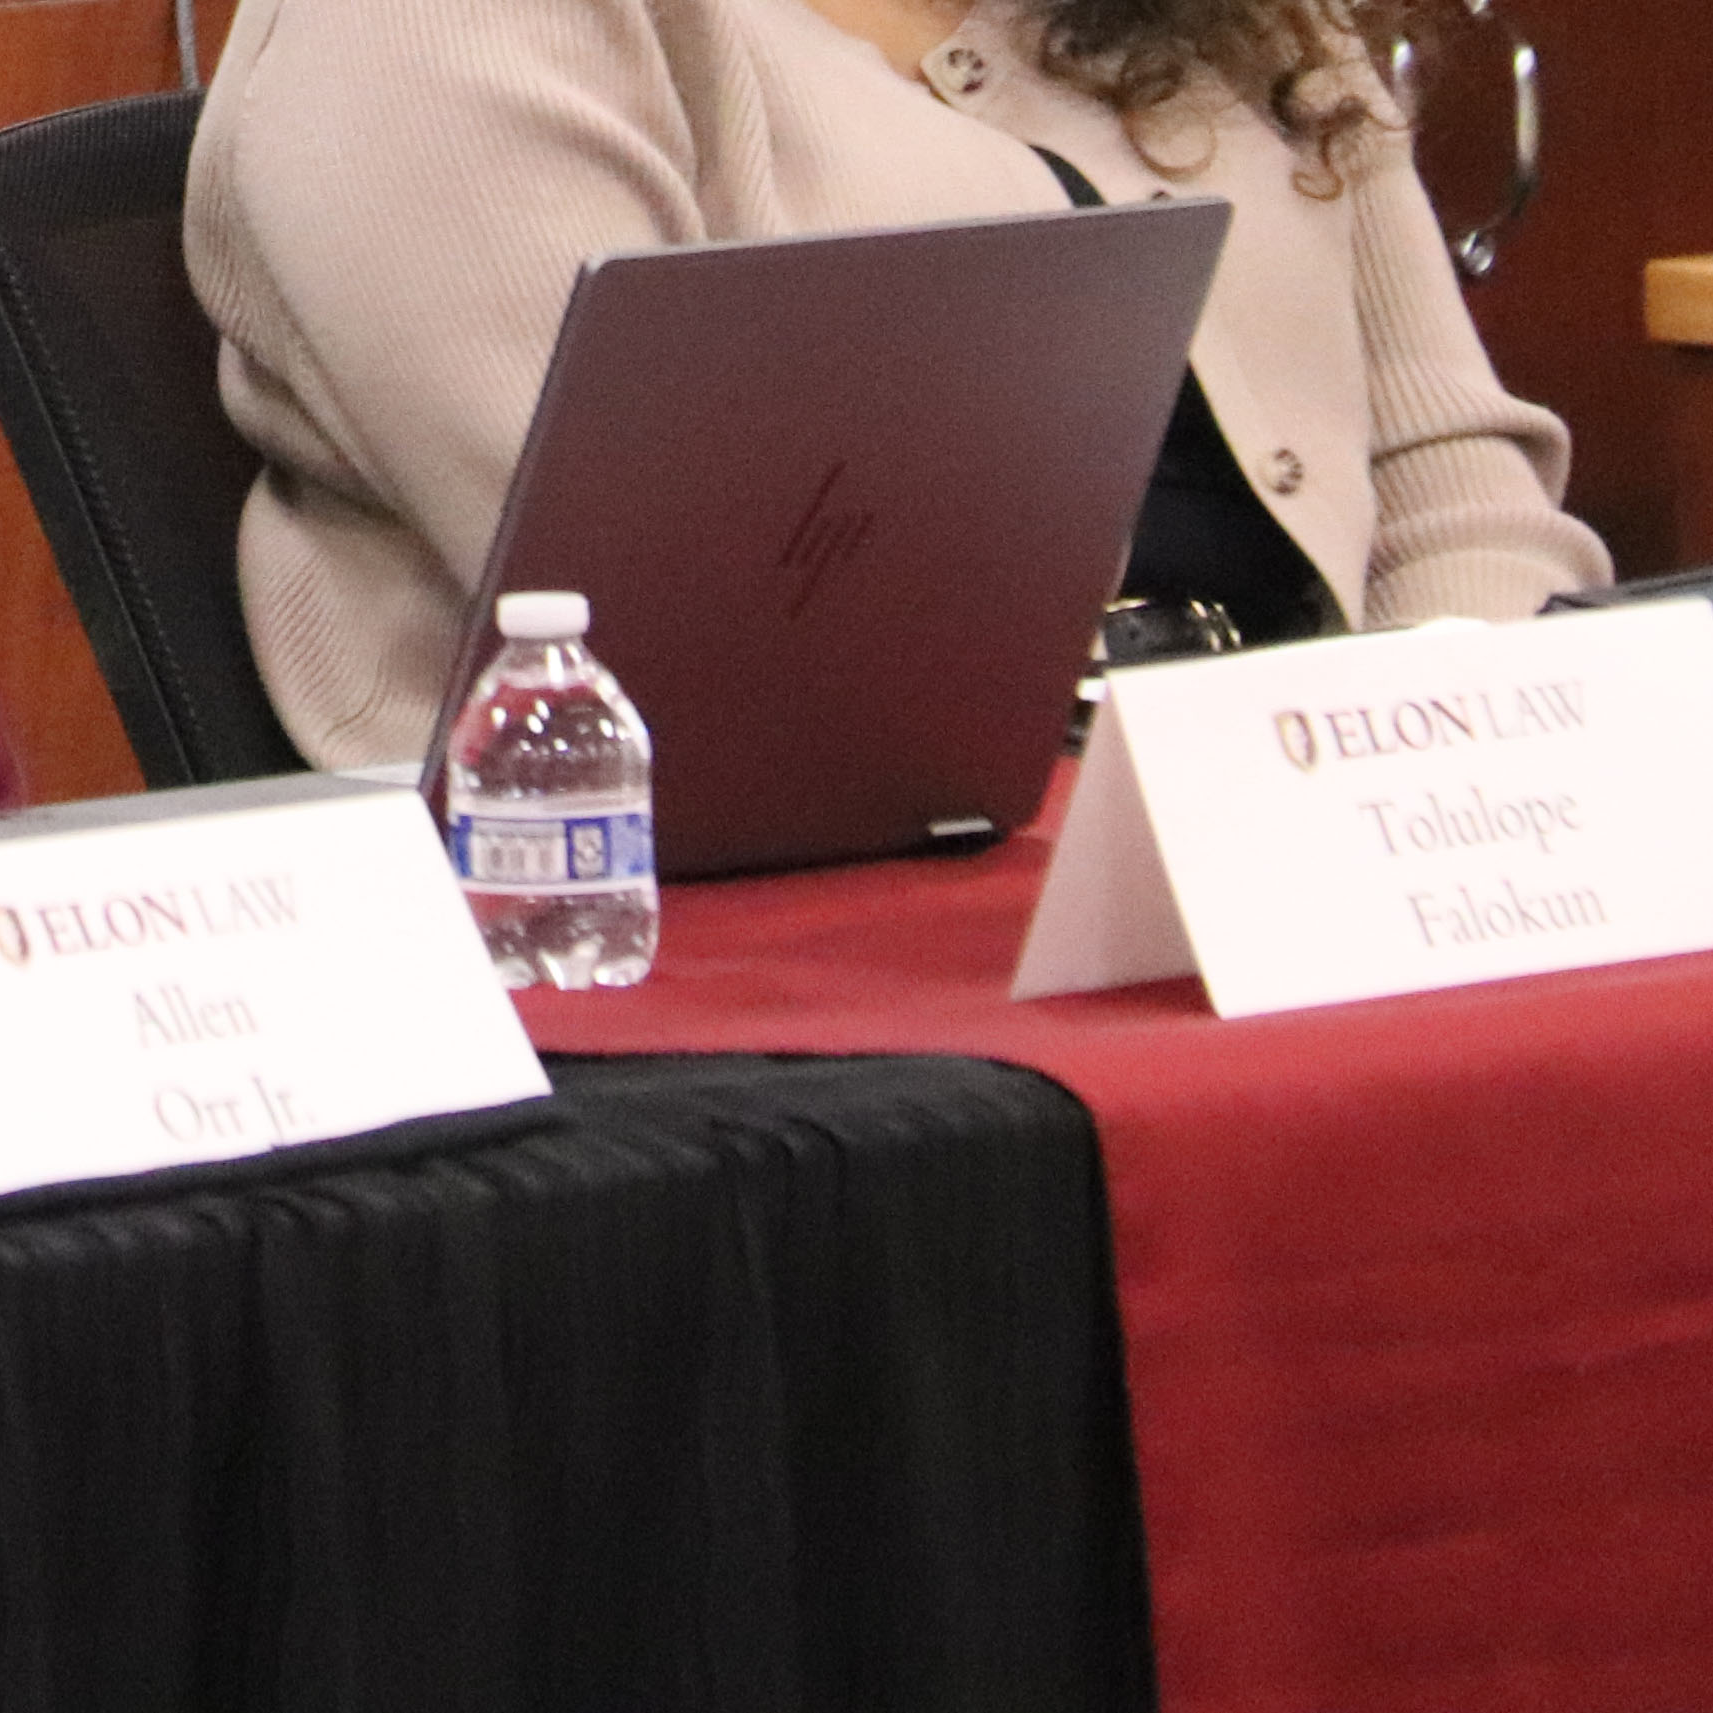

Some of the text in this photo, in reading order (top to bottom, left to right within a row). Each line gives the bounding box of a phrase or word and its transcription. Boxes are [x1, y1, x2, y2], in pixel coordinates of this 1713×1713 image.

[1324, 680, 1585, 761] ELON LAW
[1358, 784, 1583, 856] Tolulope
[36, 873, 300, 956] ELON LAW
[1406, 876, 1611, 948] Falokun
[132, 983, 260, 1049] Allen
[152, 1071, 317, 1145] Orr Jr.
